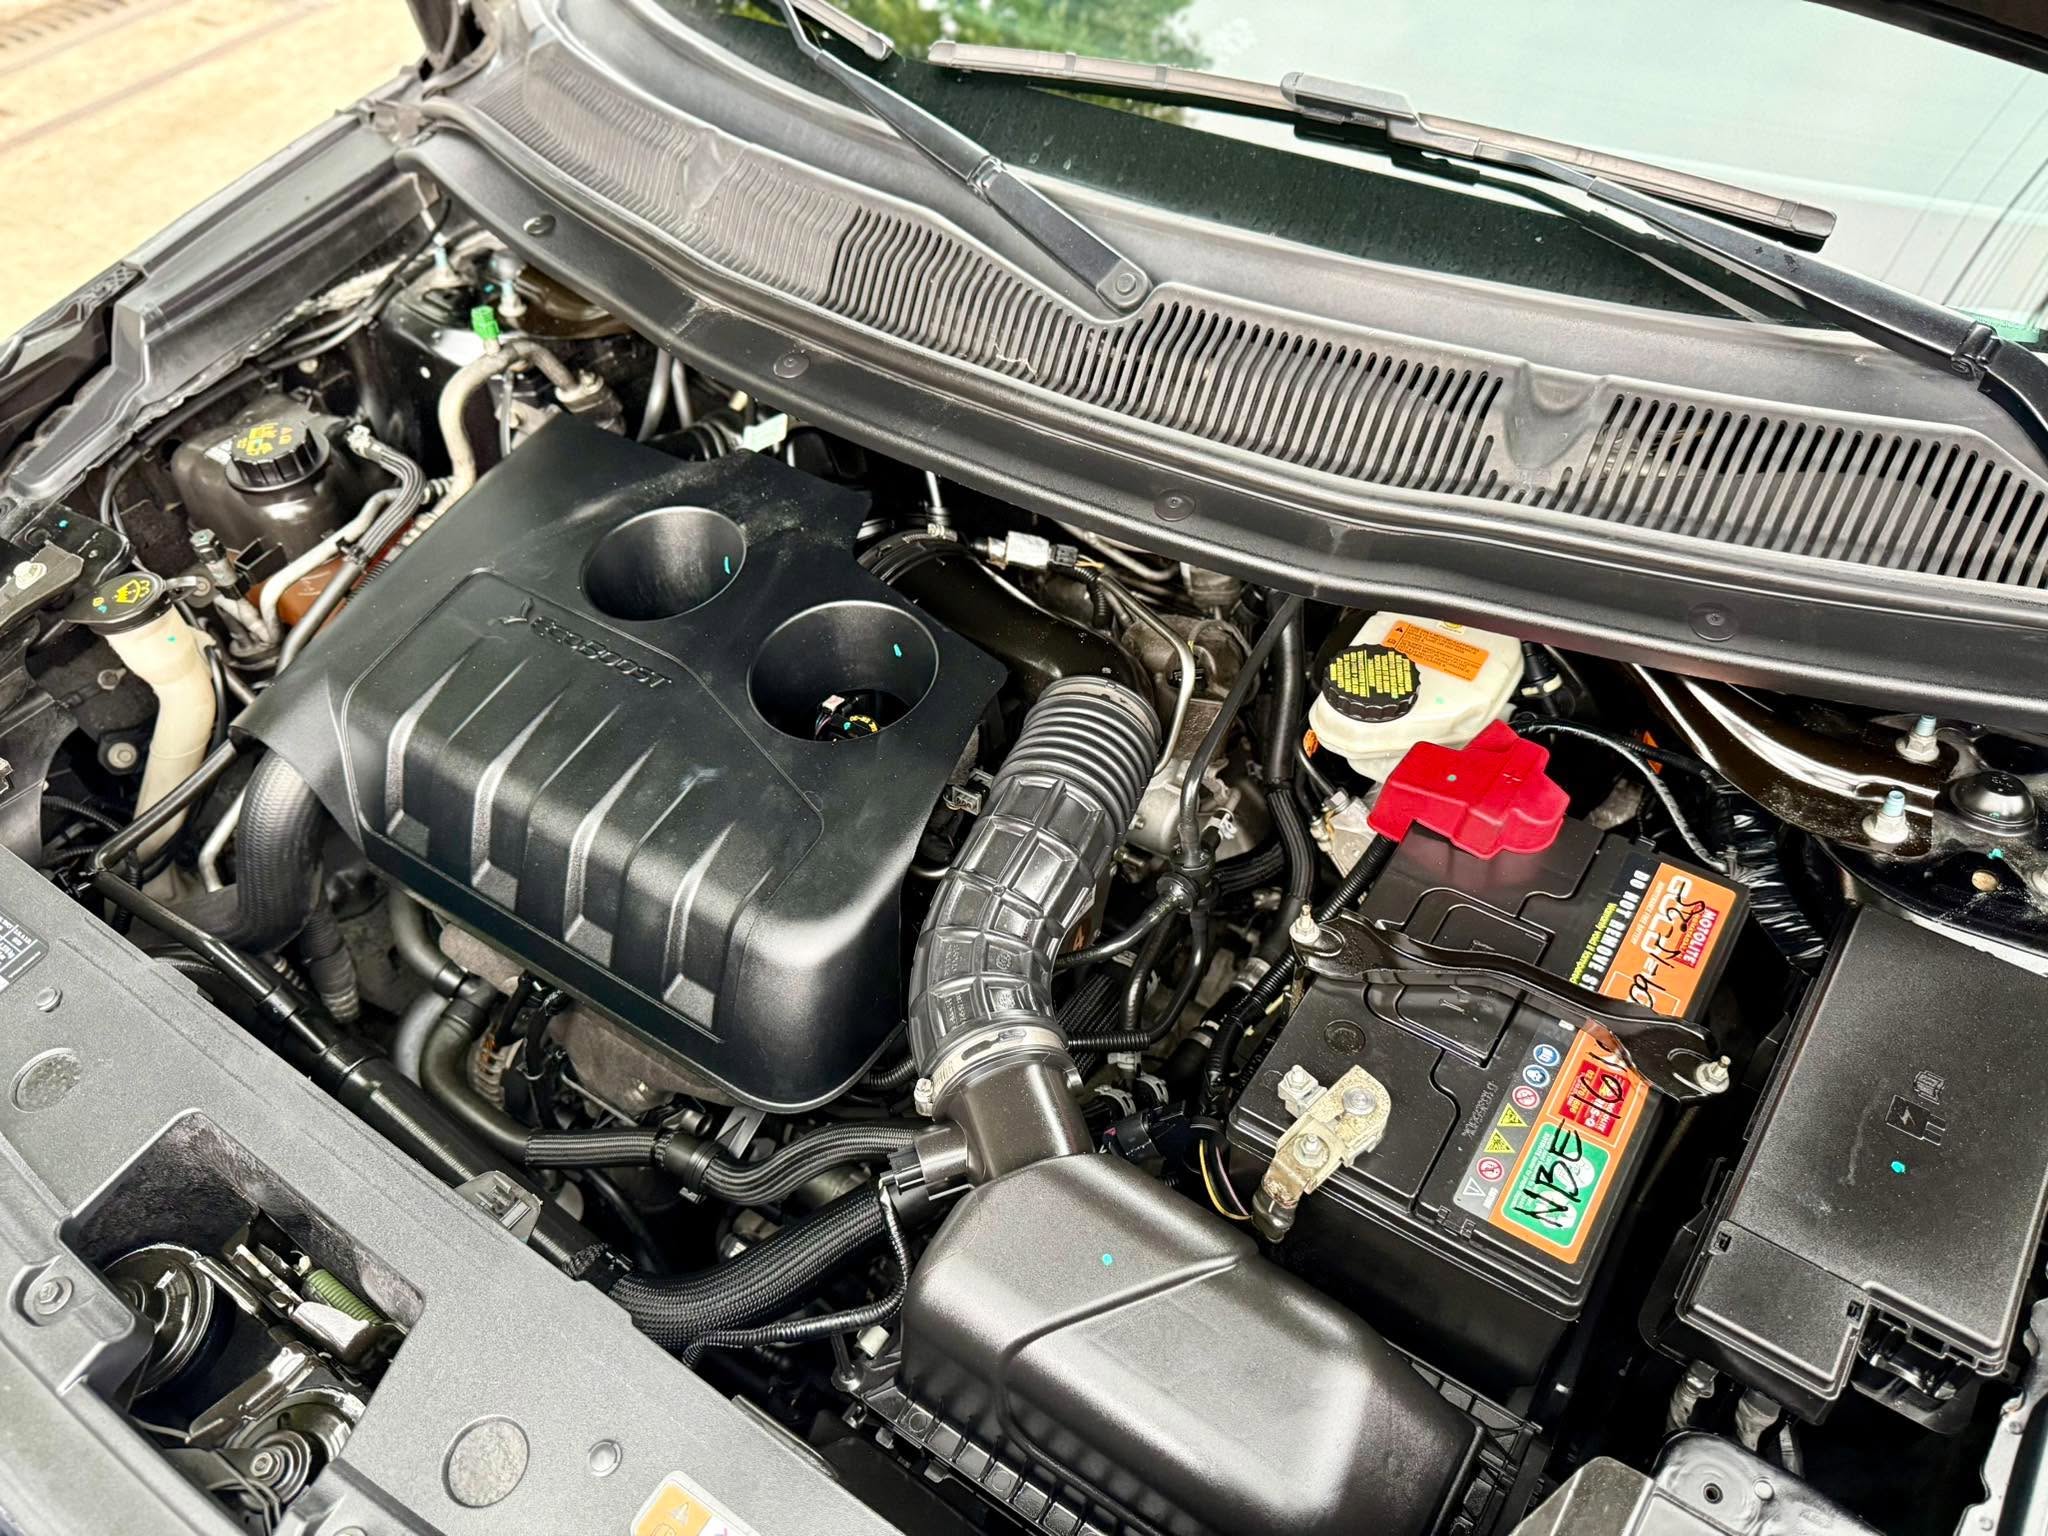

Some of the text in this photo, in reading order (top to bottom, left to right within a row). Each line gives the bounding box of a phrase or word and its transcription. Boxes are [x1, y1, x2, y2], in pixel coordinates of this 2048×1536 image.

[1629, 869, 1650, 890] DO
[1595, 902, 1617, 931] Warranty
[1615, 890, 1640, 919] NOT
[1588, 929, 1603, 946] void
[1588, 919, 1626, 973] REMOVE
[1682, 908, 1717, 964] MOTOLITE
[1513, 1118, 1583, 1228] NBE
